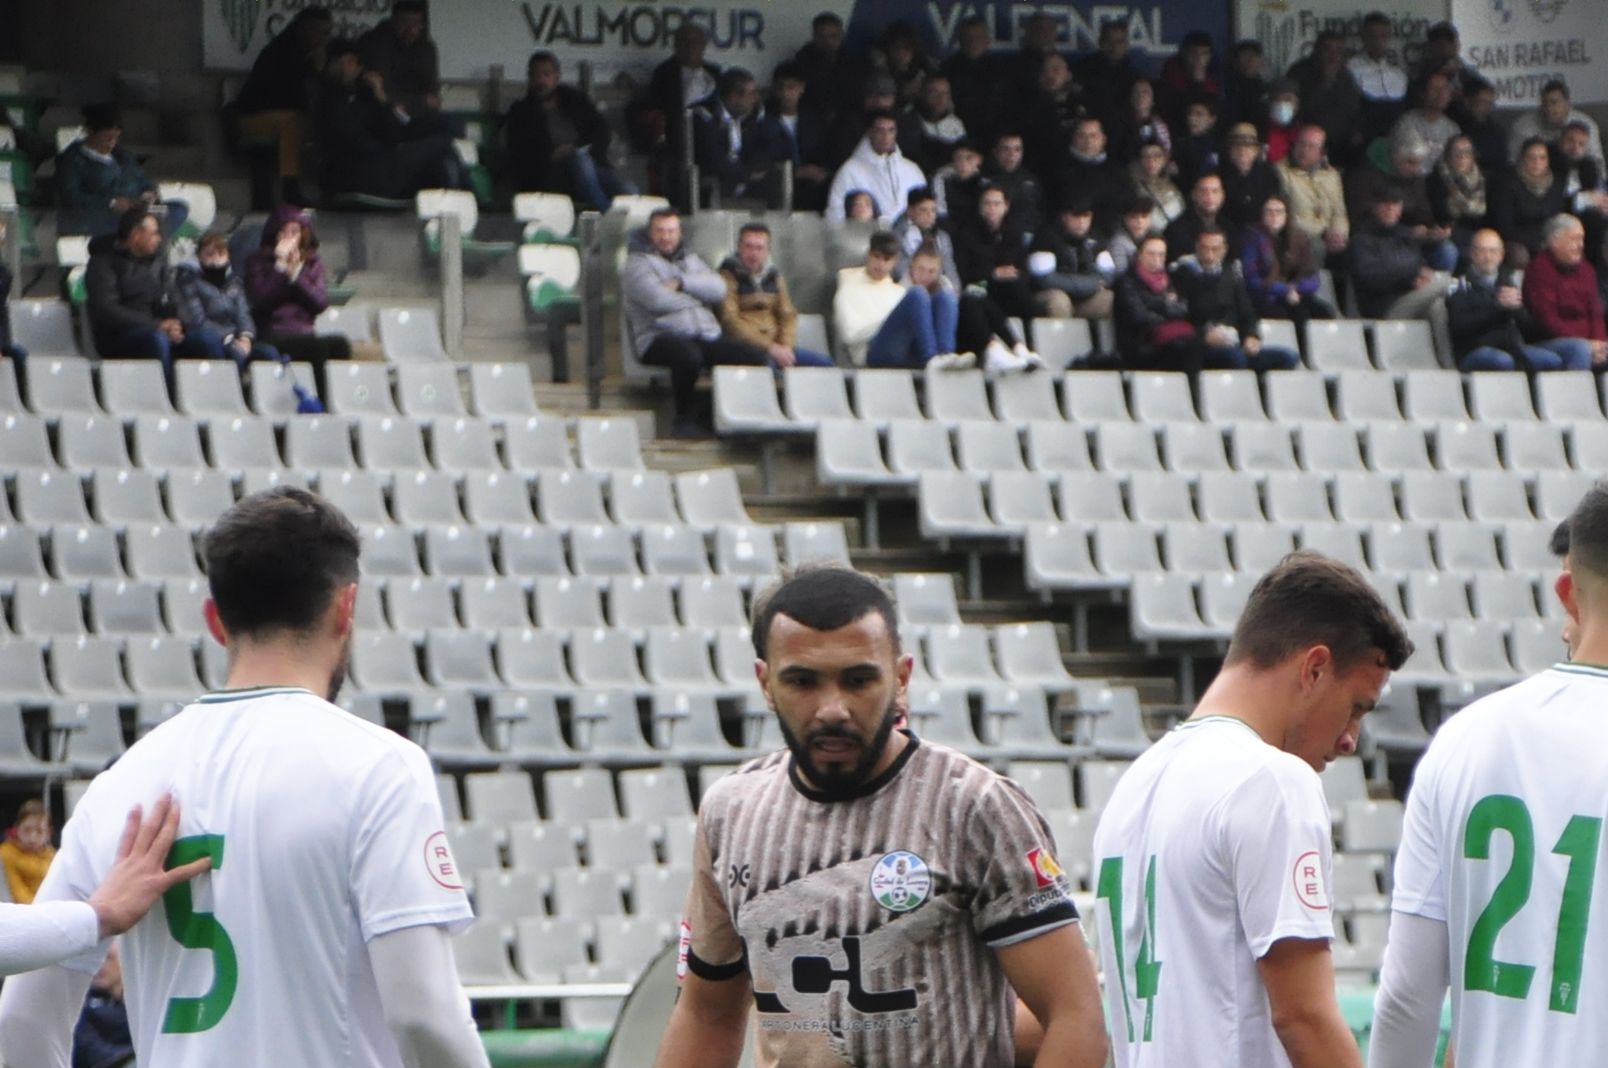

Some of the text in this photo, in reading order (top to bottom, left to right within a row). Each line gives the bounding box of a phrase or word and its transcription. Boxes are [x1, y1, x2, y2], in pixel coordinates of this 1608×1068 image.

[1299, 9, 1431, 38] Fundión
[1469, 38, 1592, 69] SAN RAFAEL
[161, 833, 239, 1034] 5
[1096, 854, 1163, 1043] 14
[1464, 794, 1603, 1015] 21
